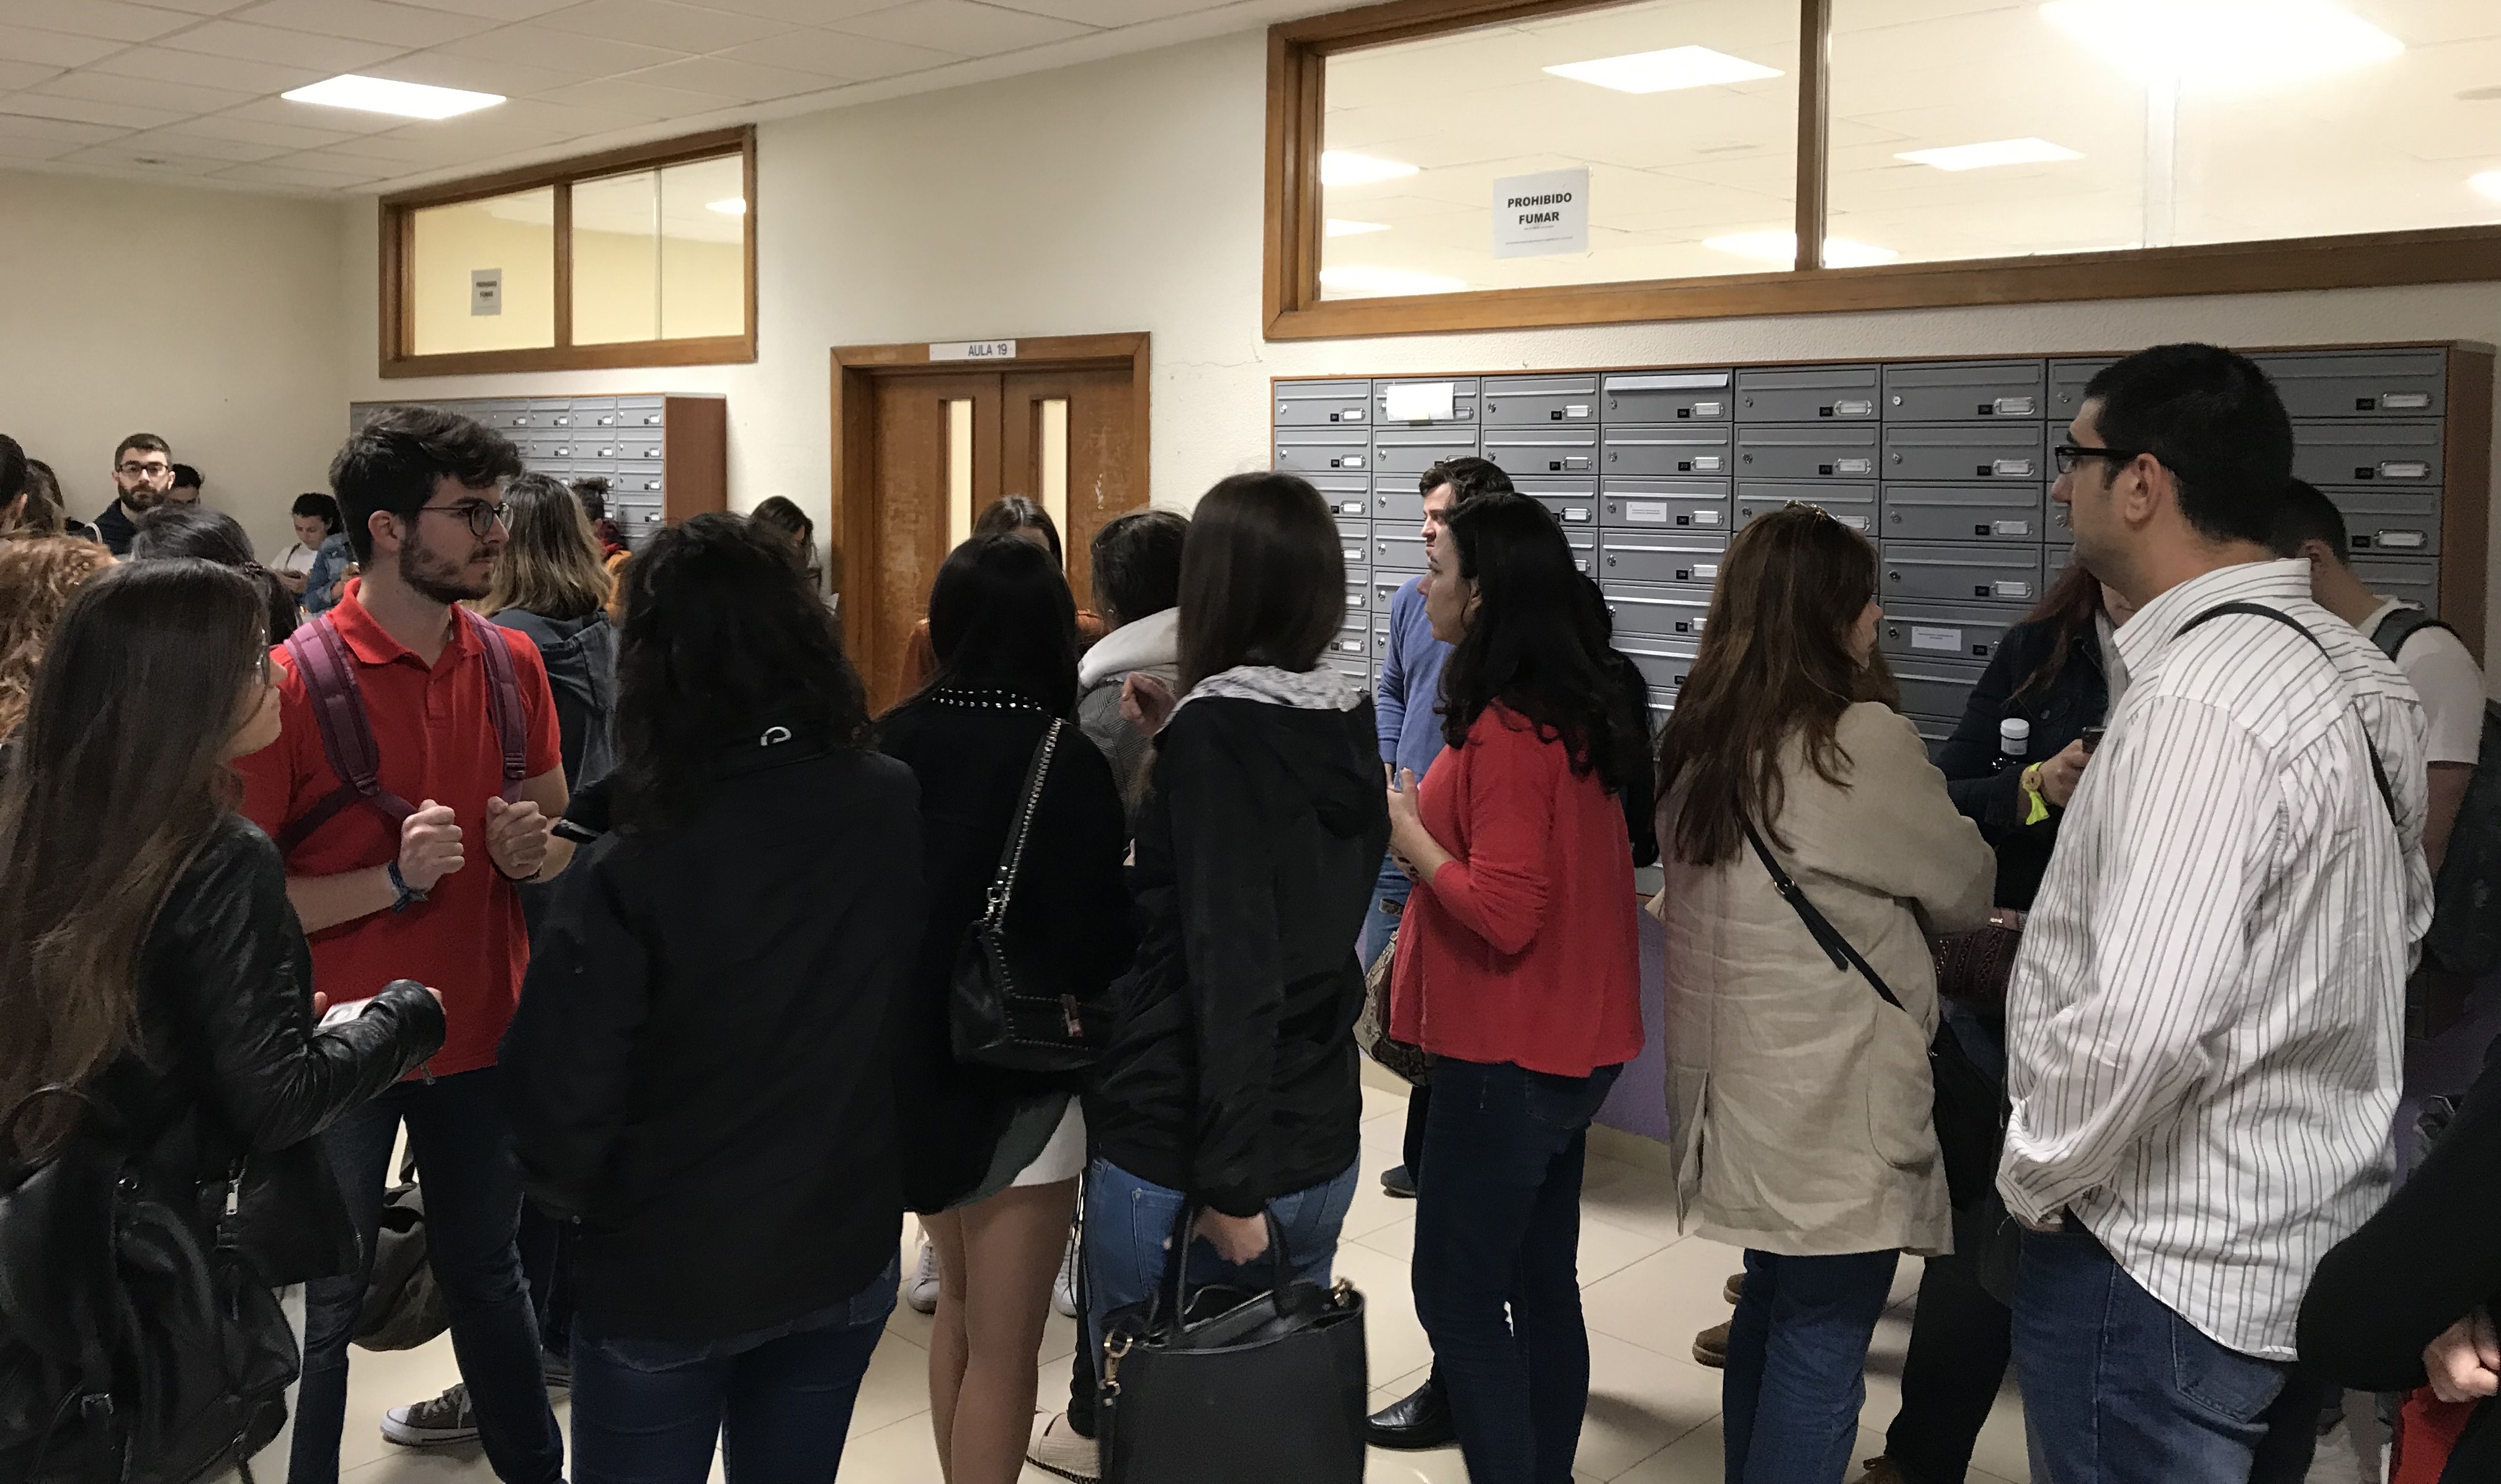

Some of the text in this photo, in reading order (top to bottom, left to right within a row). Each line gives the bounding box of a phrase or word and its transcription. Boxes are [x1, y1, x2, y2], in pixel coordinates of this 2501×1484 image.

[1507, 192, 1572, 208] PROHIBIDO
[1518, 211, 1559, 224] FUMAR
[968, 343, 1007, 357] AULA 19
